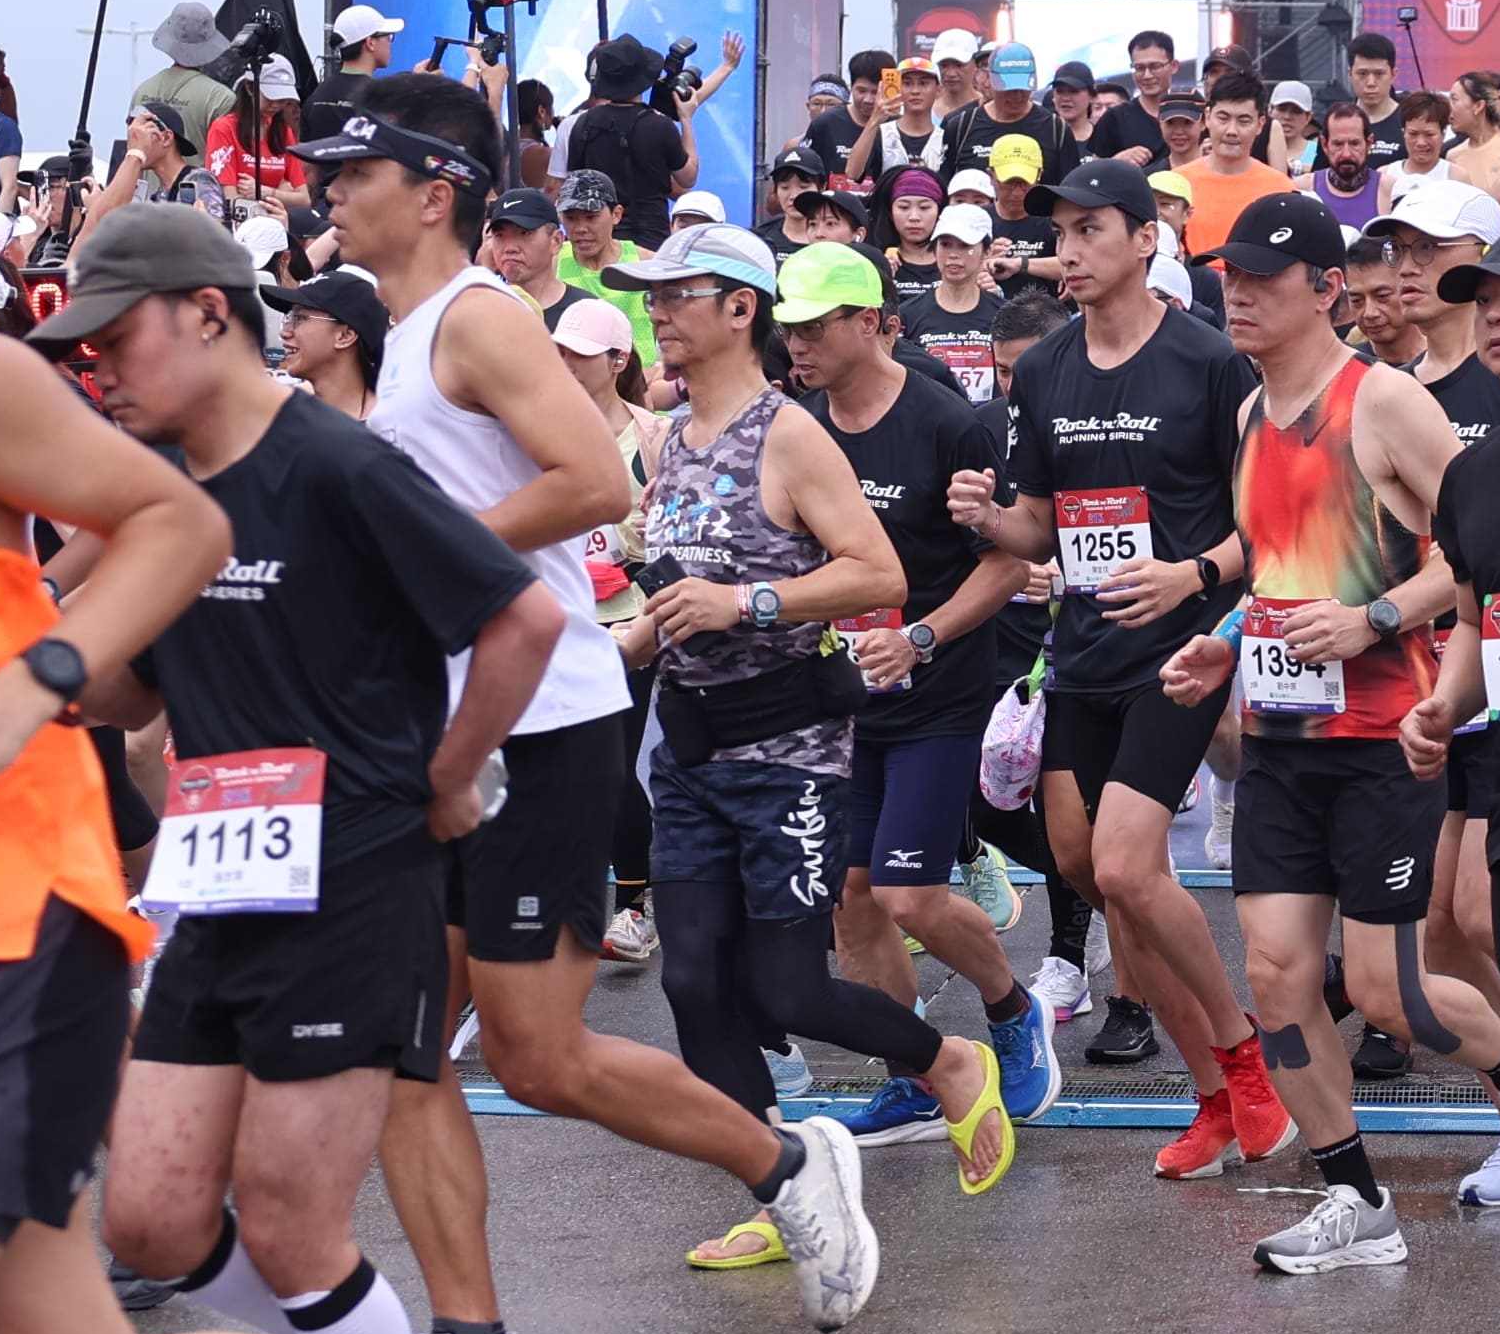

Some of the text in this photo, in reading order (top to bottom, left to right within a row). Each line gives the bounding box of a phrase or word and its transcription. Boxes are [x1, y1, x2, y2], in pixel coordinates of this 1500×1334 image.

[920, 333, 957, 344] Rock
[968, 330, 993, 342] Rol
[956, 370, 985, 389] 57
[1052, 417, 1101, 435] Rock
[1117, 412, 1158, 432] Roll
[860, 479, 902, 500] Roll
[868, 500, 890, 510] RIES
[583, 530, 608, 557] 29
[1072, 531, 1136, 563] 1255
[217, 556, 286, 584] Roll
[181, 816, 292, 868] 1113
